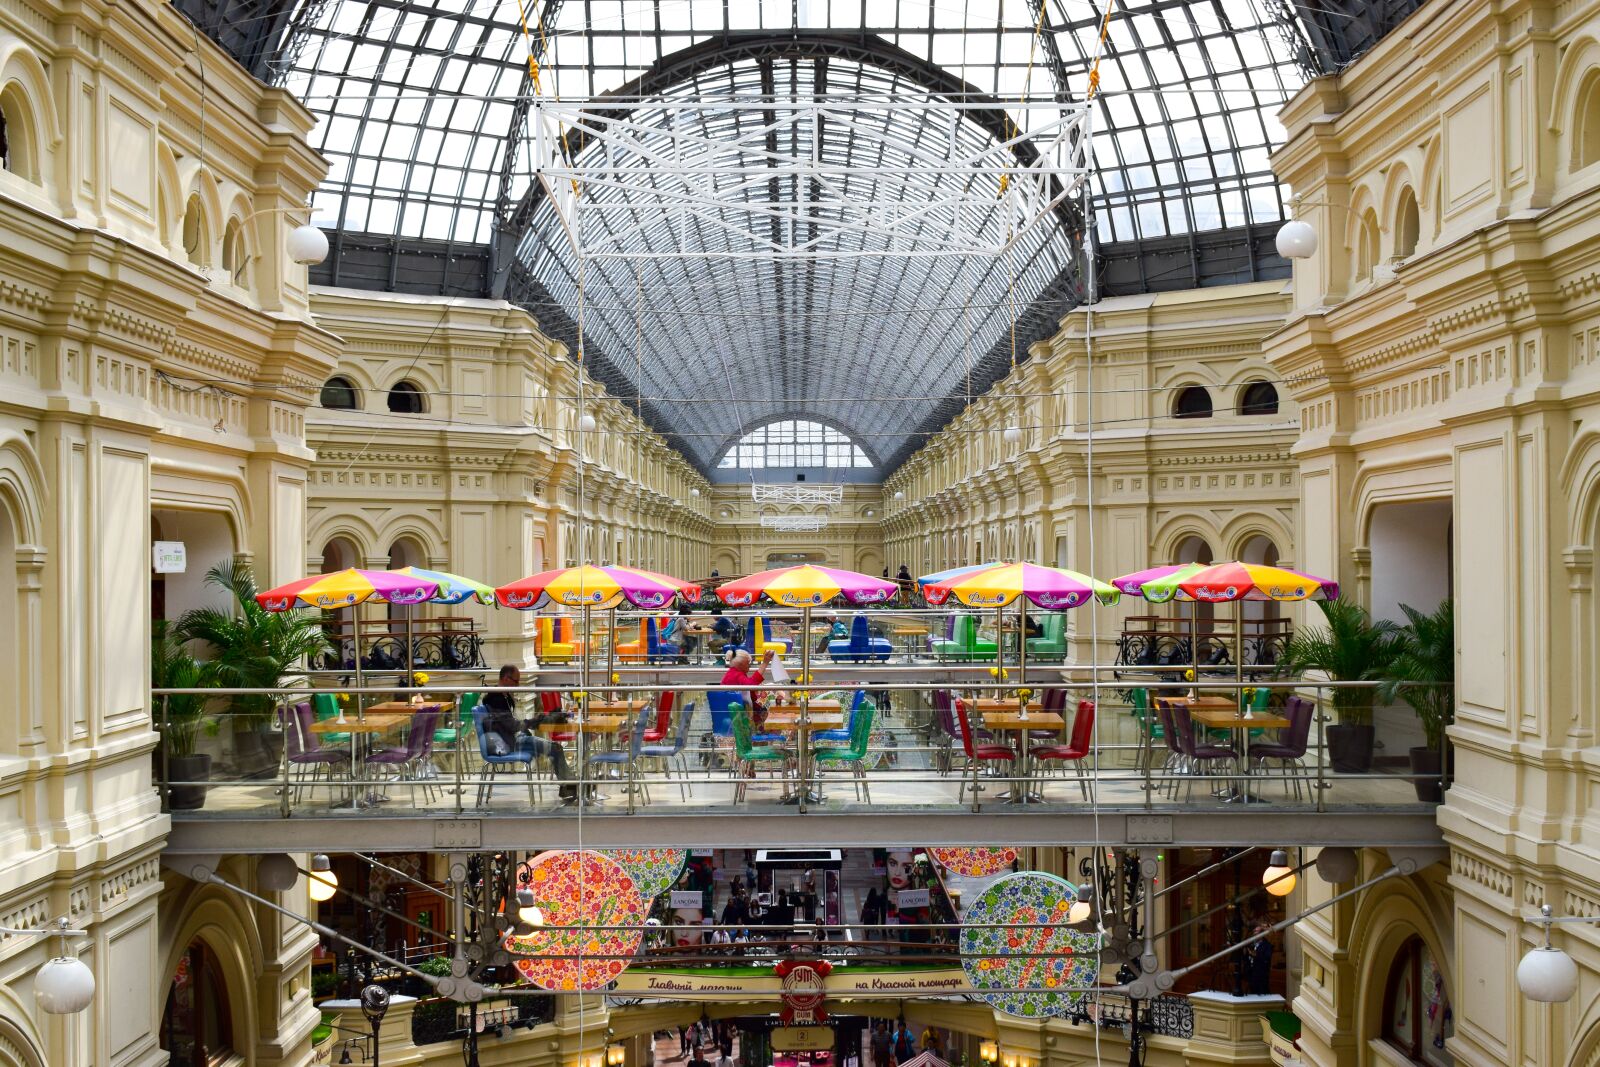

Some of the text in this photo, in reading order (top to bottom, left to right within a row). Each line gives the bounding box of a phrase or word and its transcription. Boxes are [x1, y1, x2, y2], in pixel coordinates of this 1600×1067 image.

[793, 968, 812, 983] ГУМ
[648, 977, 692, 991] Главный
[855, 977, 963, 990] на Красной площади
